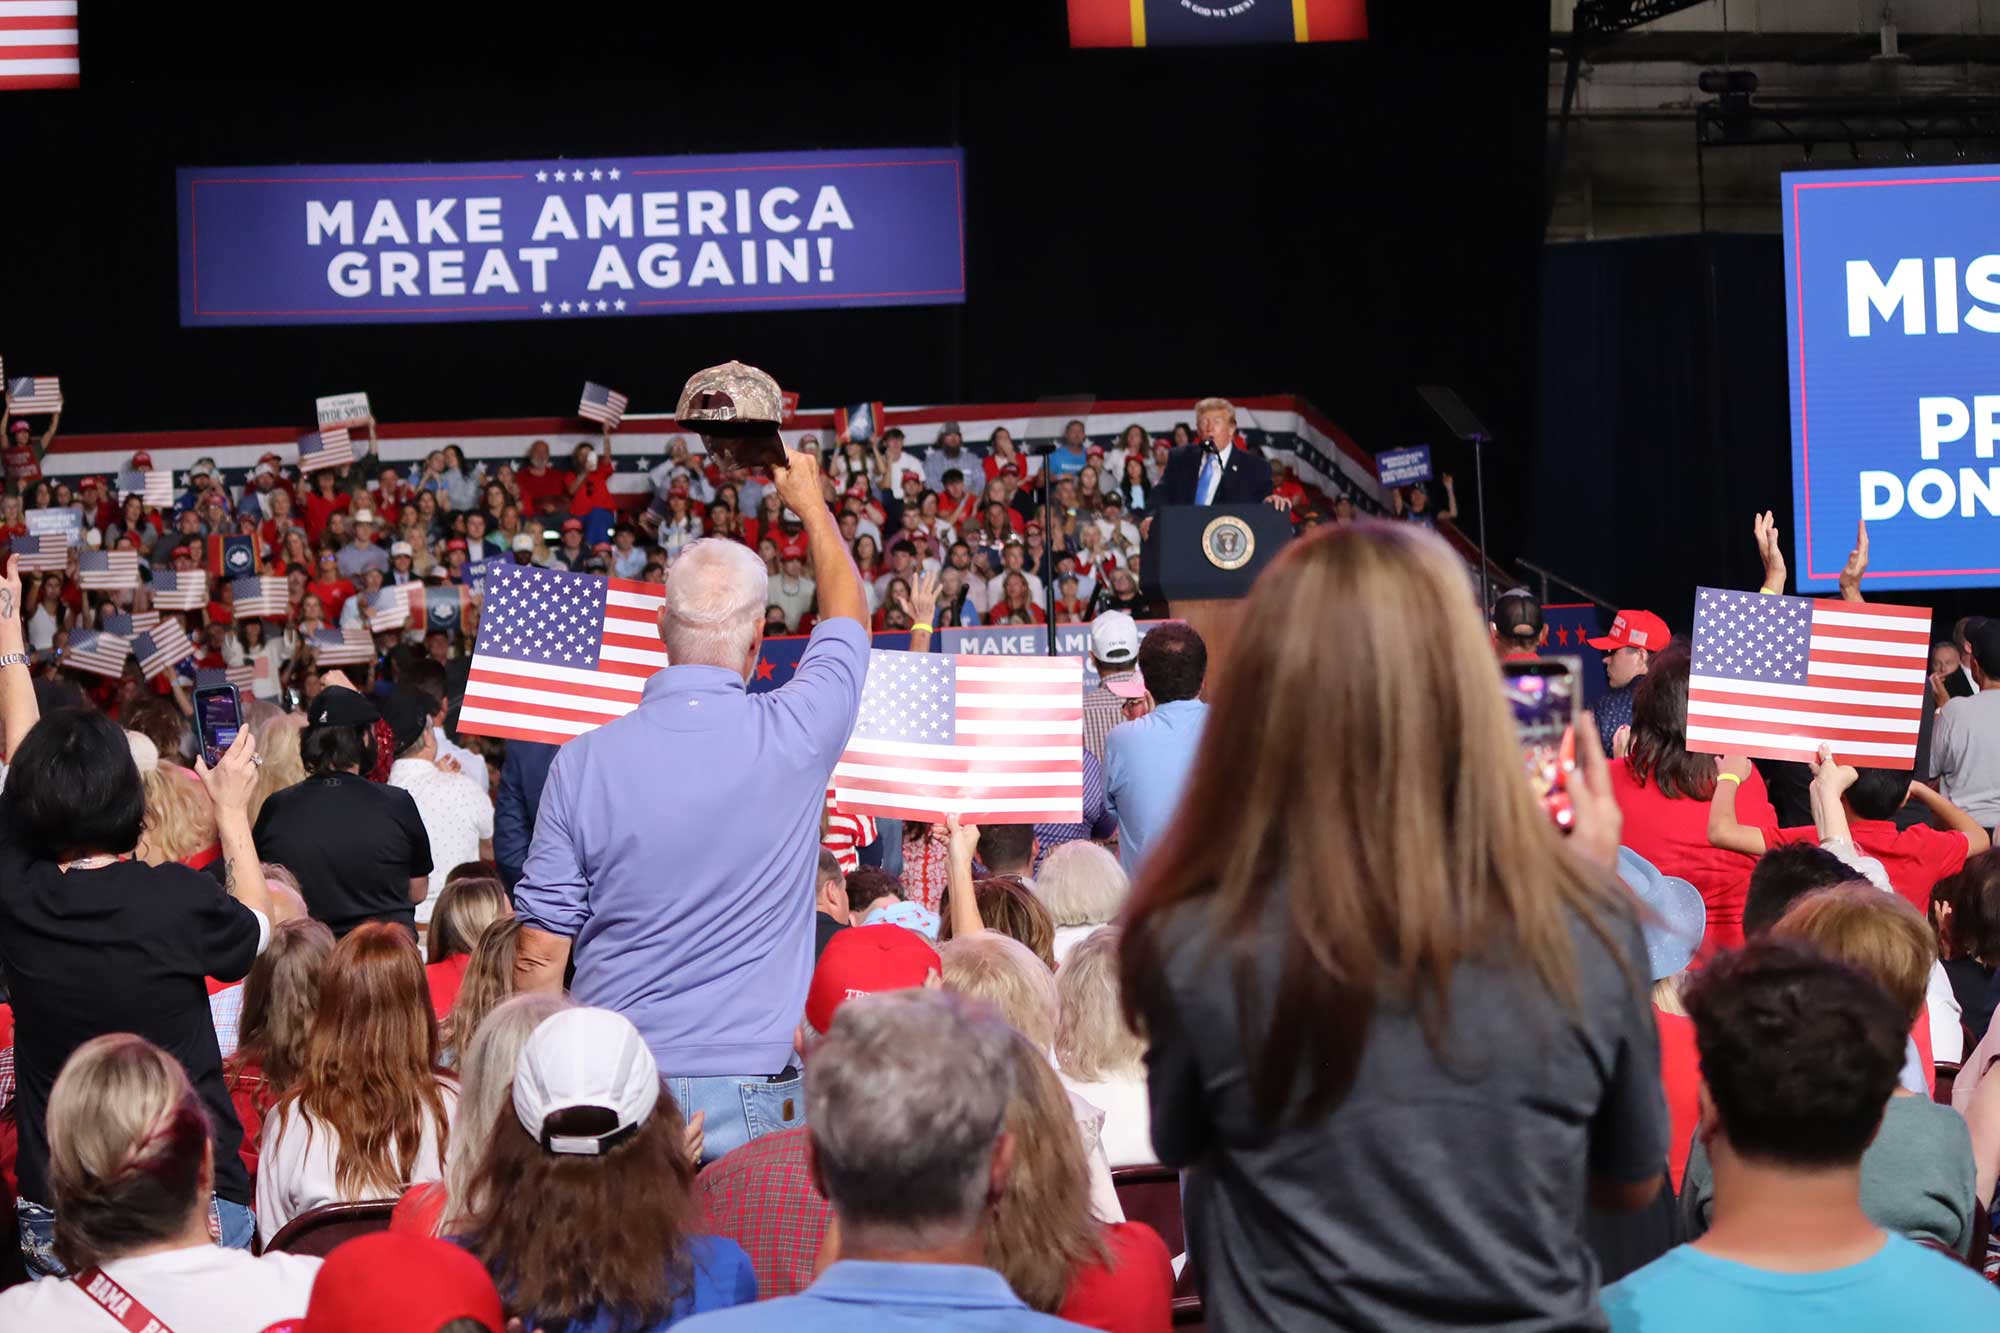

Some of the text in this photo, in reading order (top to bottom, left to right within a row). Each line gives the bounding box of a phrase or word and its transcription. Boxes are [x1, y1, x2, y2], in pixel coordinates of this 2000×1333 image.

[1191, 4, 1212, 16] GOD
[1212, 8, 1227, 17] WE
[306, 185, 855, 246] MAKE AMERICA
[327, 237, 835, 298] GREAT AGAIN!
[1846, 253, 2000, 337] MIS
[1860, 467, 2000, 522] DON
[960, 635, 1035, 655] MAKE
[86, 1272, 133, 1320] BAMA
